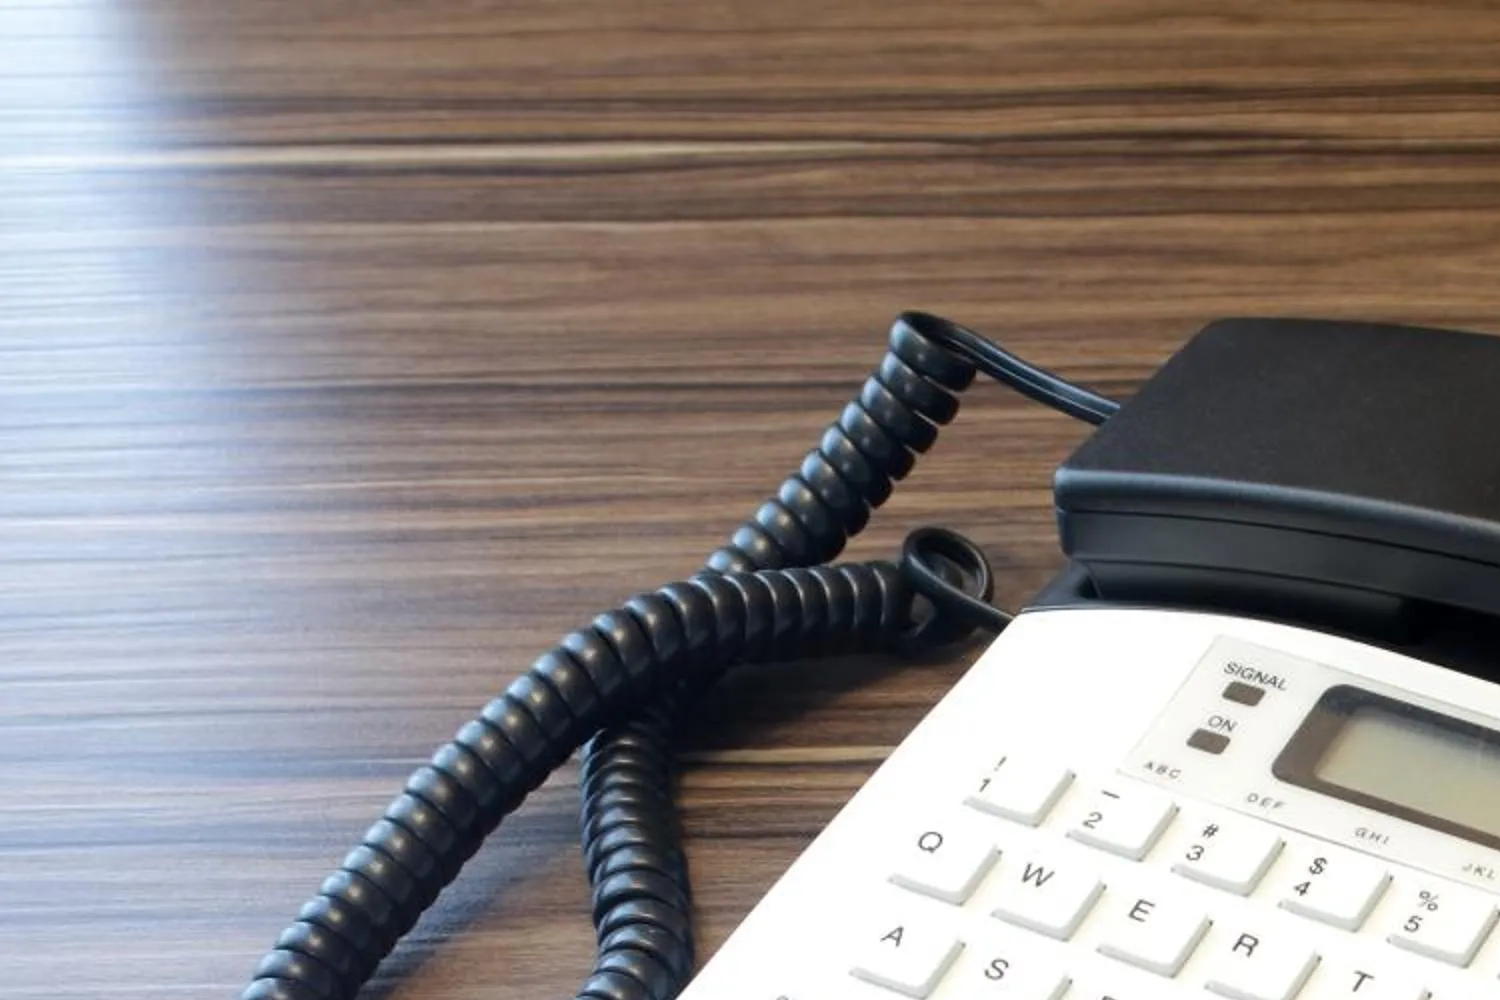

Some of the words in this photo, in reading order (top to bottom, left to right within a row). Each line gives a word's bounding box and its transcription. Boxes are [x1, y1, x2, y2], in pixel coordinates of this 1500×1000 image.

[1223, 661, 1288, 691] SIGNAL
[1207, 714, 1238, 732] ON
[1143, 760, 1182, 779] ABC
[979, 777, 991, 793] 1
[1246, 792, 1287, 810] DEF
[1082, 811, 1103, 830] 2
[917, 831, 944, 854] Q
[1353, 826, 1391, 846] GHI
[1185, 844, 1205, 862] 3
[1021, 863, 1055, 888] W
[1461, 862, 1497, 880] JKL
[1294, 881, 1311, 897] 4
[1128, 898, 1156, 923] E
[1403, 915, 1423, 933] 5
[880, 925, 905, 948] A
[1231, 933, 1259, 958] R
[983, 958, 1010, 981] S
[1352, 970, 1375, 993] T
